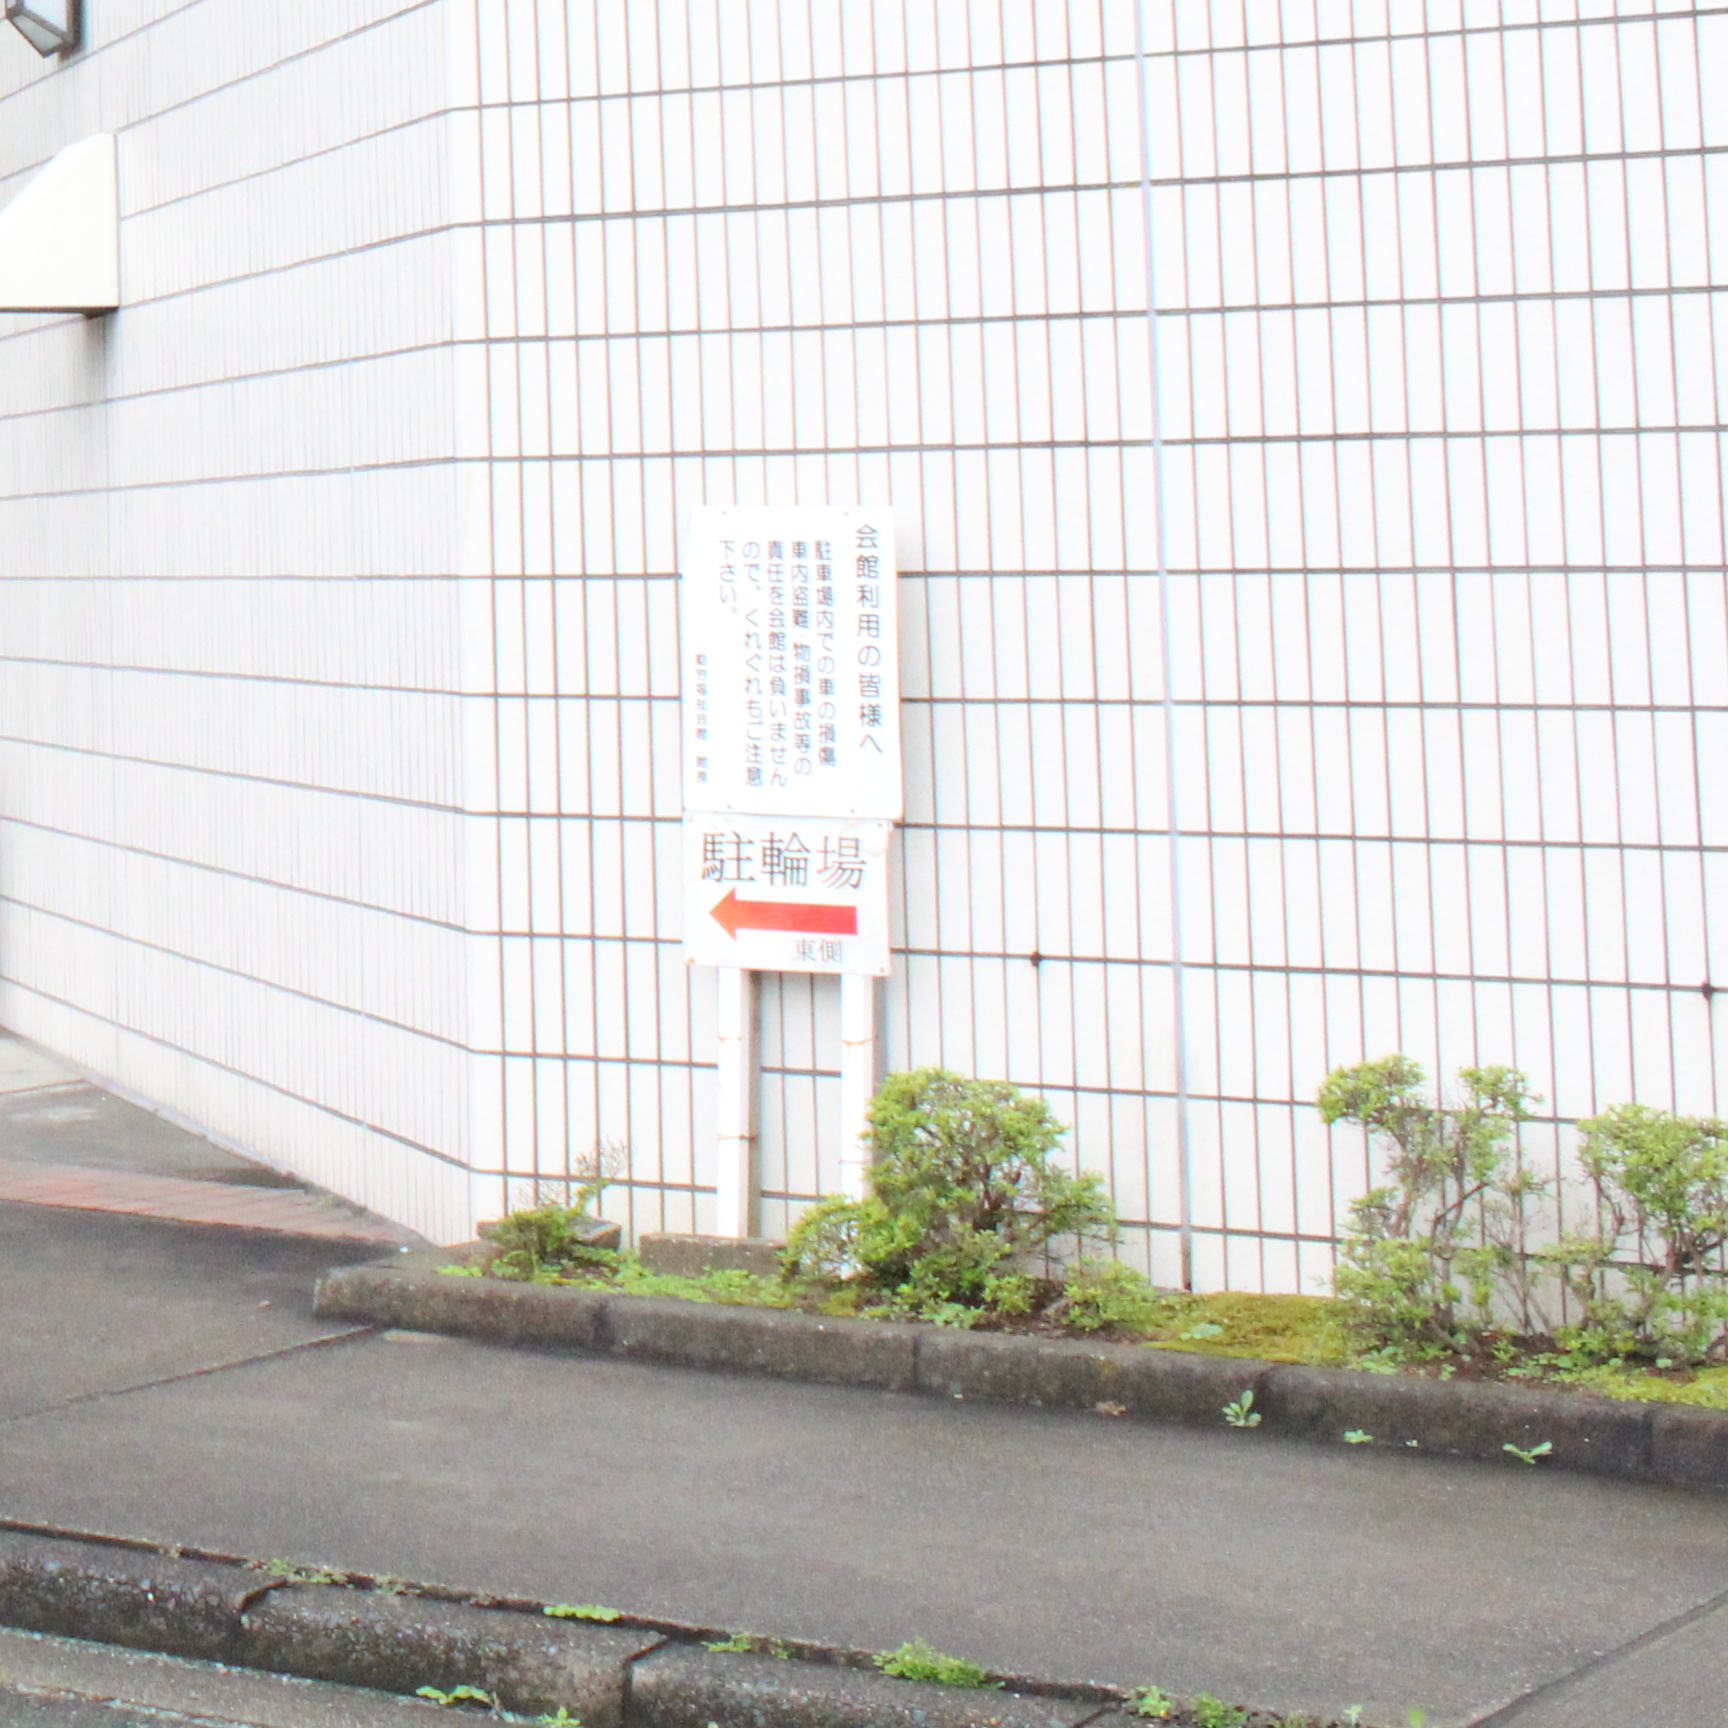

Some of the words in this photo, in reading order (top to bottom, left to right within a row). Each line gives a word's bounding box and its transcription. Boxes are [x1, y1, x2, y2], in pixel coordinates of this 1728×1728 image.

[718, 540, 738, 614] 下さい。
[766, 540, 787, 787] 責任を会館は負いません
[855, 524, 883, 754] 会館利用の皆様へ
[700, 830, 867, 890] 駐輪場
[793, 937, 843, 963] 東側
